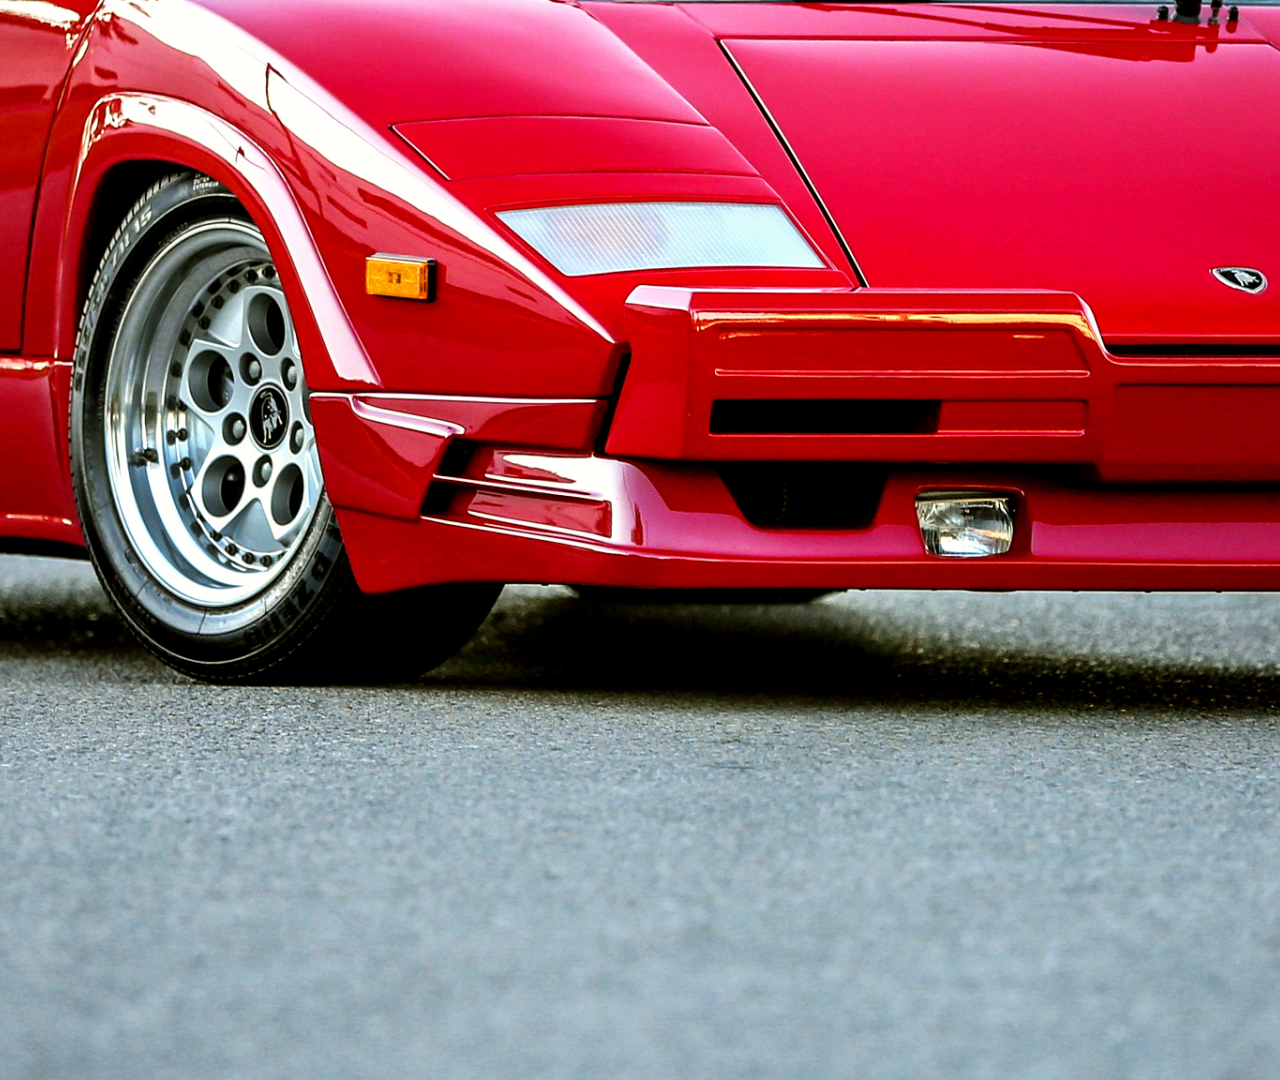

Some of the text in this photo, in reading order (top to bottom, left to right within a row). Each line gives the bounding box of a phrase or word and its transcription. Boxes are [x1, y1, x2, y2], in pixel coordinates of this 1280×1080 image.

[132, 203, 152, 234] 15
[243, 550, 333, 647] P ZERO
